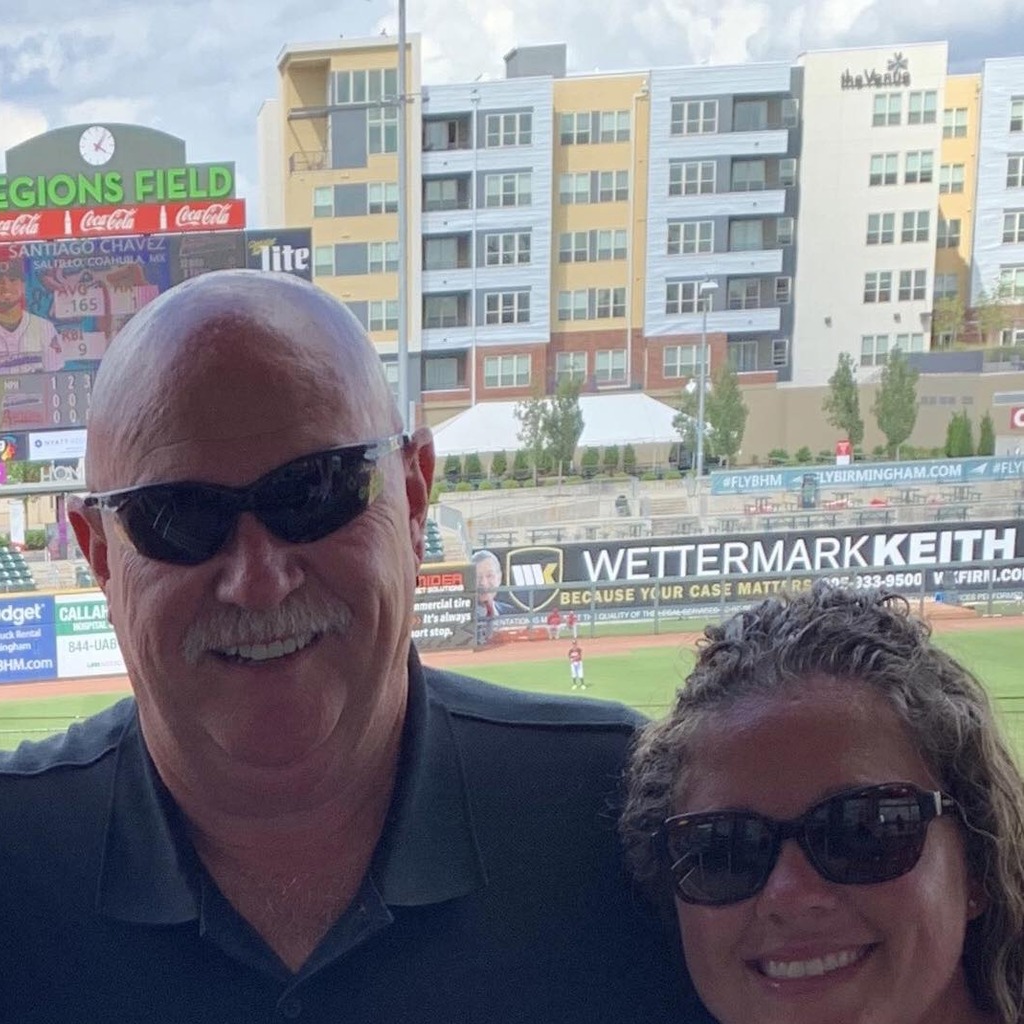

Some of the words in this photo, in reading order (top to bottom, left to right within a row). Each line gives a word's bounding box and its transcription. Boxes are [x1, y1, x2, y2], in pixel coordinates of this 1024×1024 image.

[135, 166, 233, 201] FIELD
[9, 239, 95, 259] SANTIAGO
[100, 236, 166, 254] CHAVEZ
[65, 299, 97, 313] .165
[723, 473, 782, 489] #FLYBHM
[583, 536, 870, 583] WETTERMARK
[873, 528, 1017, 566] KEITH
[418, 573, 463, 587] NIDER
[560, 587, 635, 606] BECAUSE
[689, 583, 732, 598] CASE
[453, 597, 471, 608] tire
[59, 604, 108, 622] CALLAH
[440, 611, 472, 624] always
[598, 611, 629, 620] QUALITY
[630, 610, 641, 619] OF
[16, 628, 42, 638] Rental
[429, 627, 454, 638] stop.
